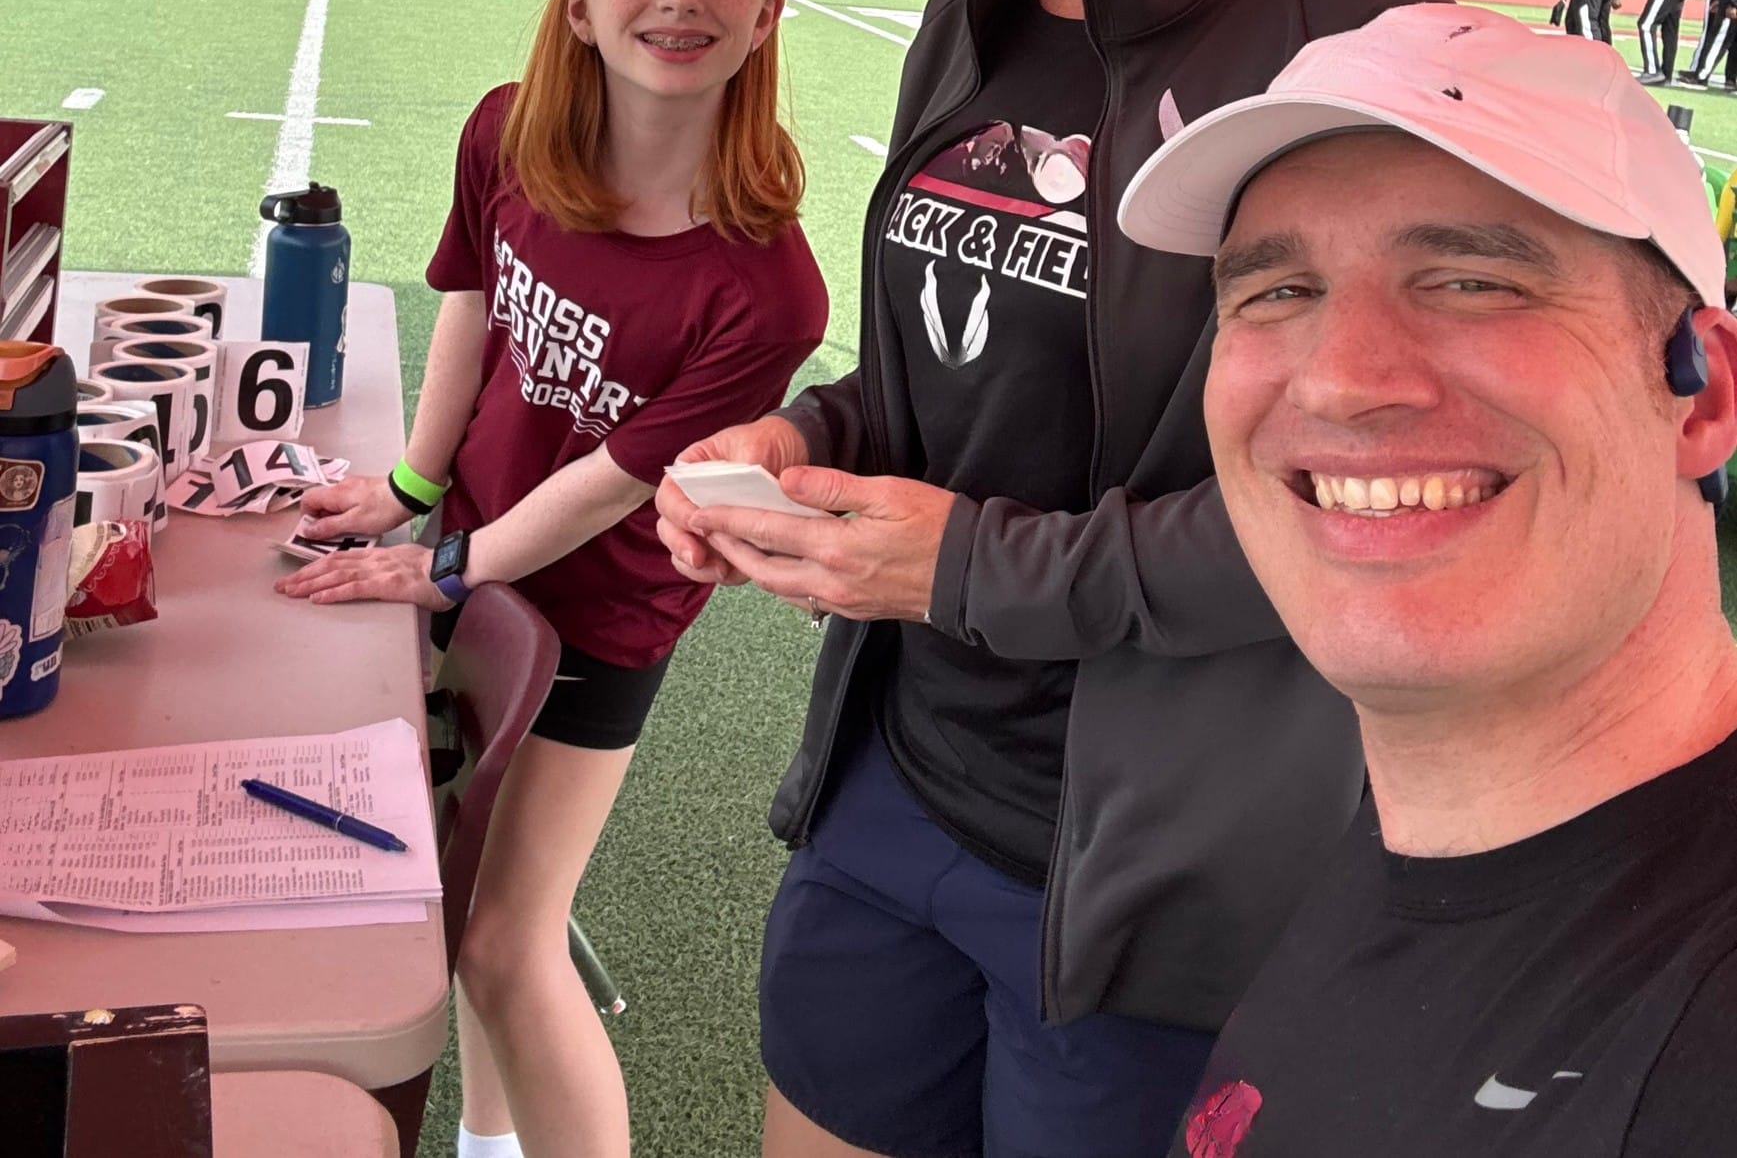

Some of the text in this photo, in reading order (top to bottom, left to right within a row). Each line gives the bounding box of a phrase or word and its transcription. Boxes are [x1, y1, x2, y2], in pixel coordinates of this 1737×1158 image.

[886, 193, 1087, 299] ACK & FIEL
[498, 240, 611, 360] CROSS
[237, 348, 295, 432] 6
[493, 282, 649, 423] COUNTR
[521, 373, 584, 420] 2025
[219, 442, 308, 491] 14
